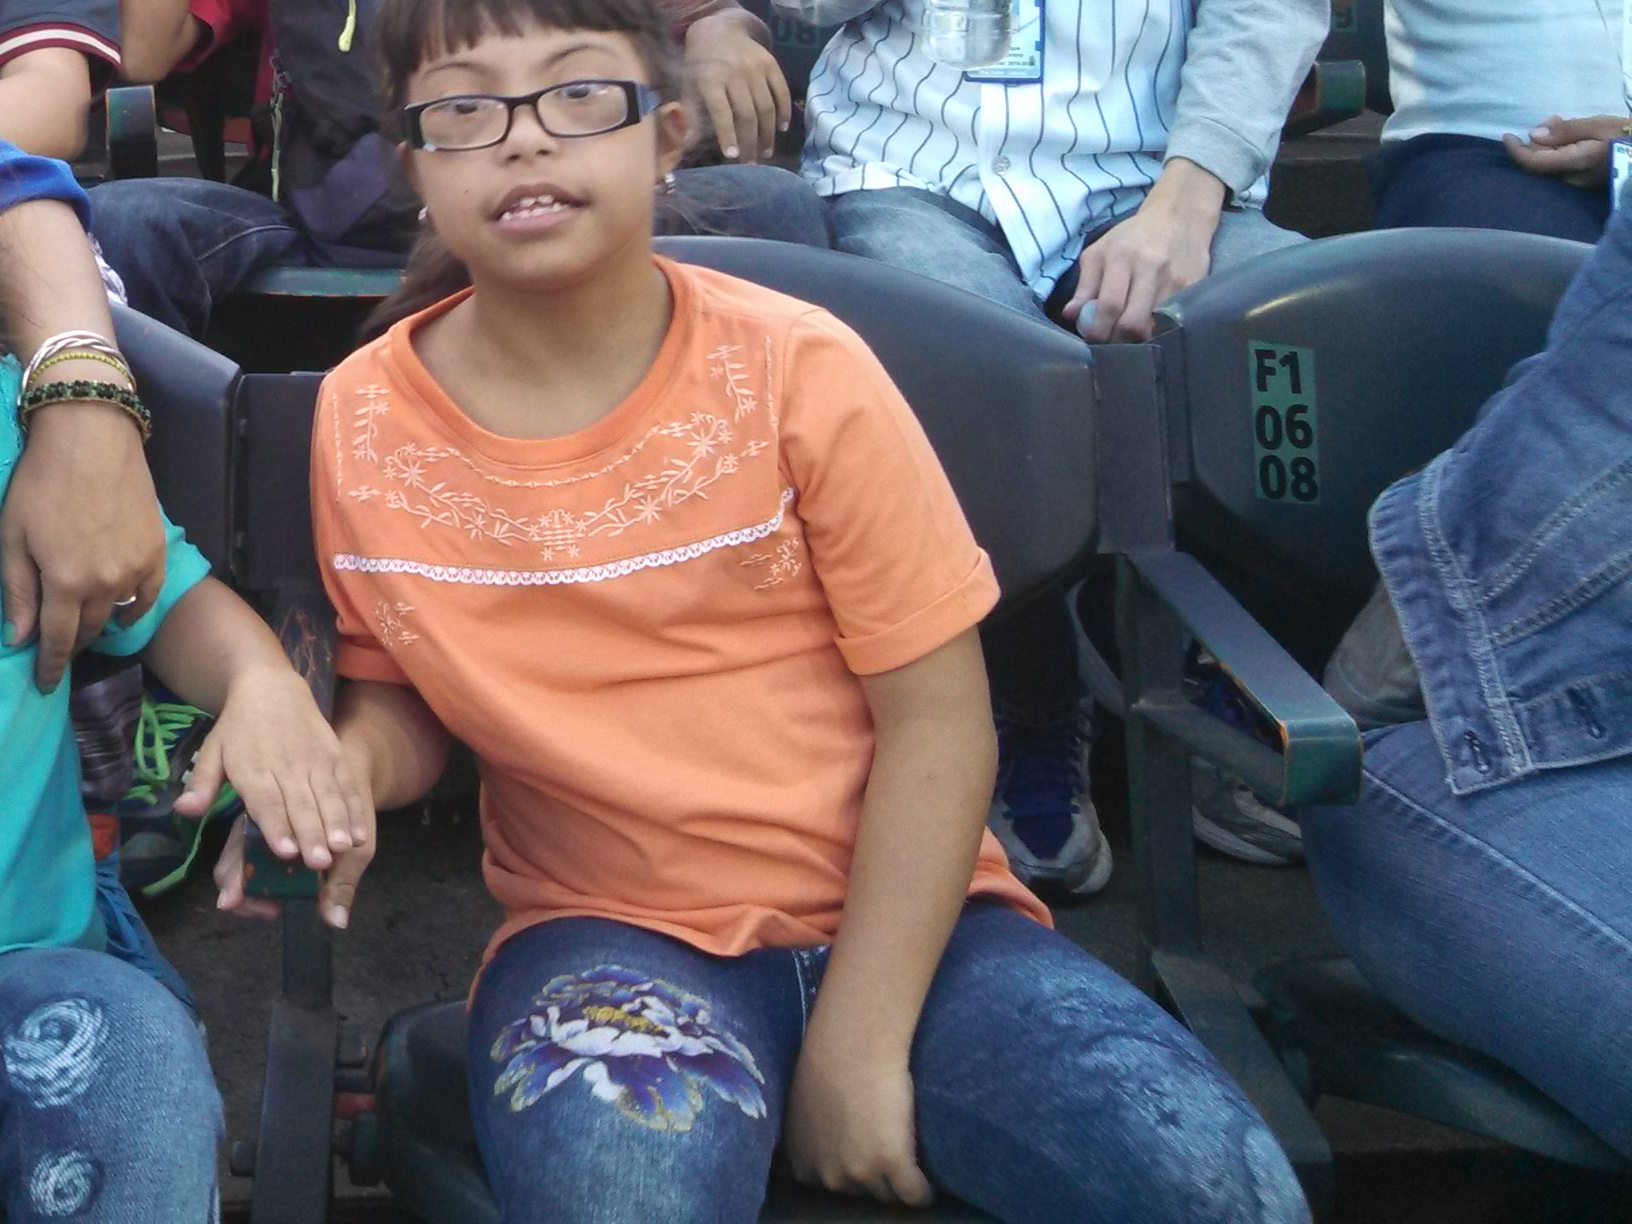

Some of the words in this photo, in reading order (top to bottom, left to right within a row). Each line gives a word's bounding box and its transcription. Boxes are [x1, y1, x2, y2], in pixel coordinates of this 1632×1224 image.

[1254, 349, 1302, 394] F1
[1255, 404, 1313, 451] 06
[1259, 454, 1318, 502] 08
